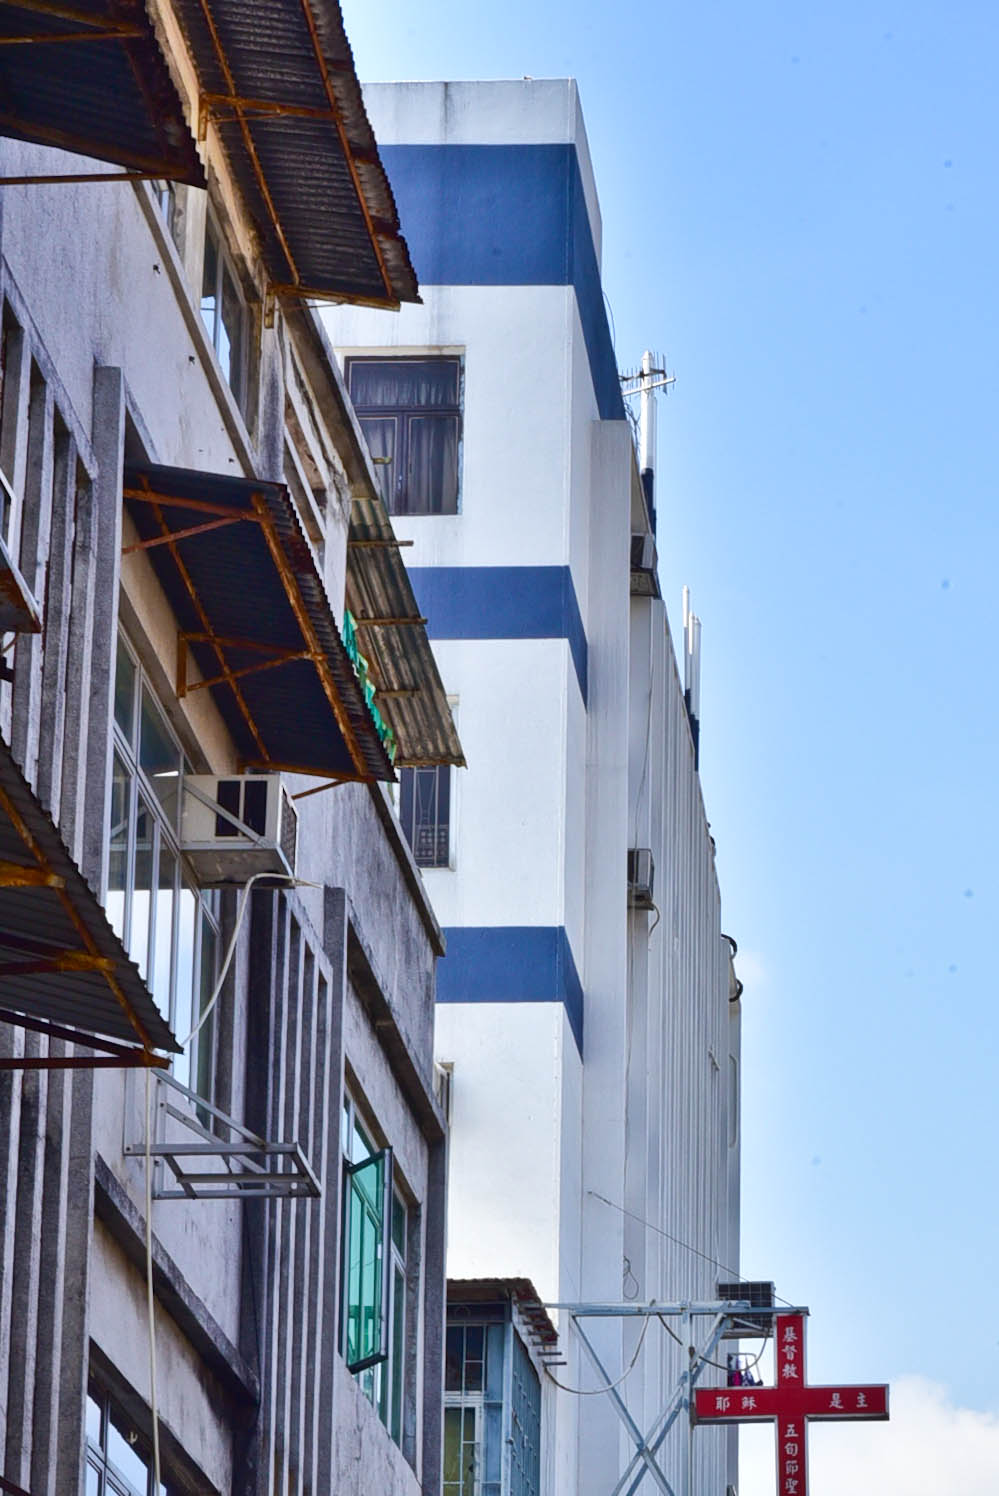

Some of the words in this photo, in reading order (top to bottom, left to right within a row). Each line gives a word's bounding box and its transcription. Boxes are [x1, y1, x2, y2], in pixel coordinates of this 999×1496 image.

[782, 1326, 799, 1379] 基督教
[715, 1396, 757, 1411] 耶穌
[829, 1392, 868, 1409] 是主
